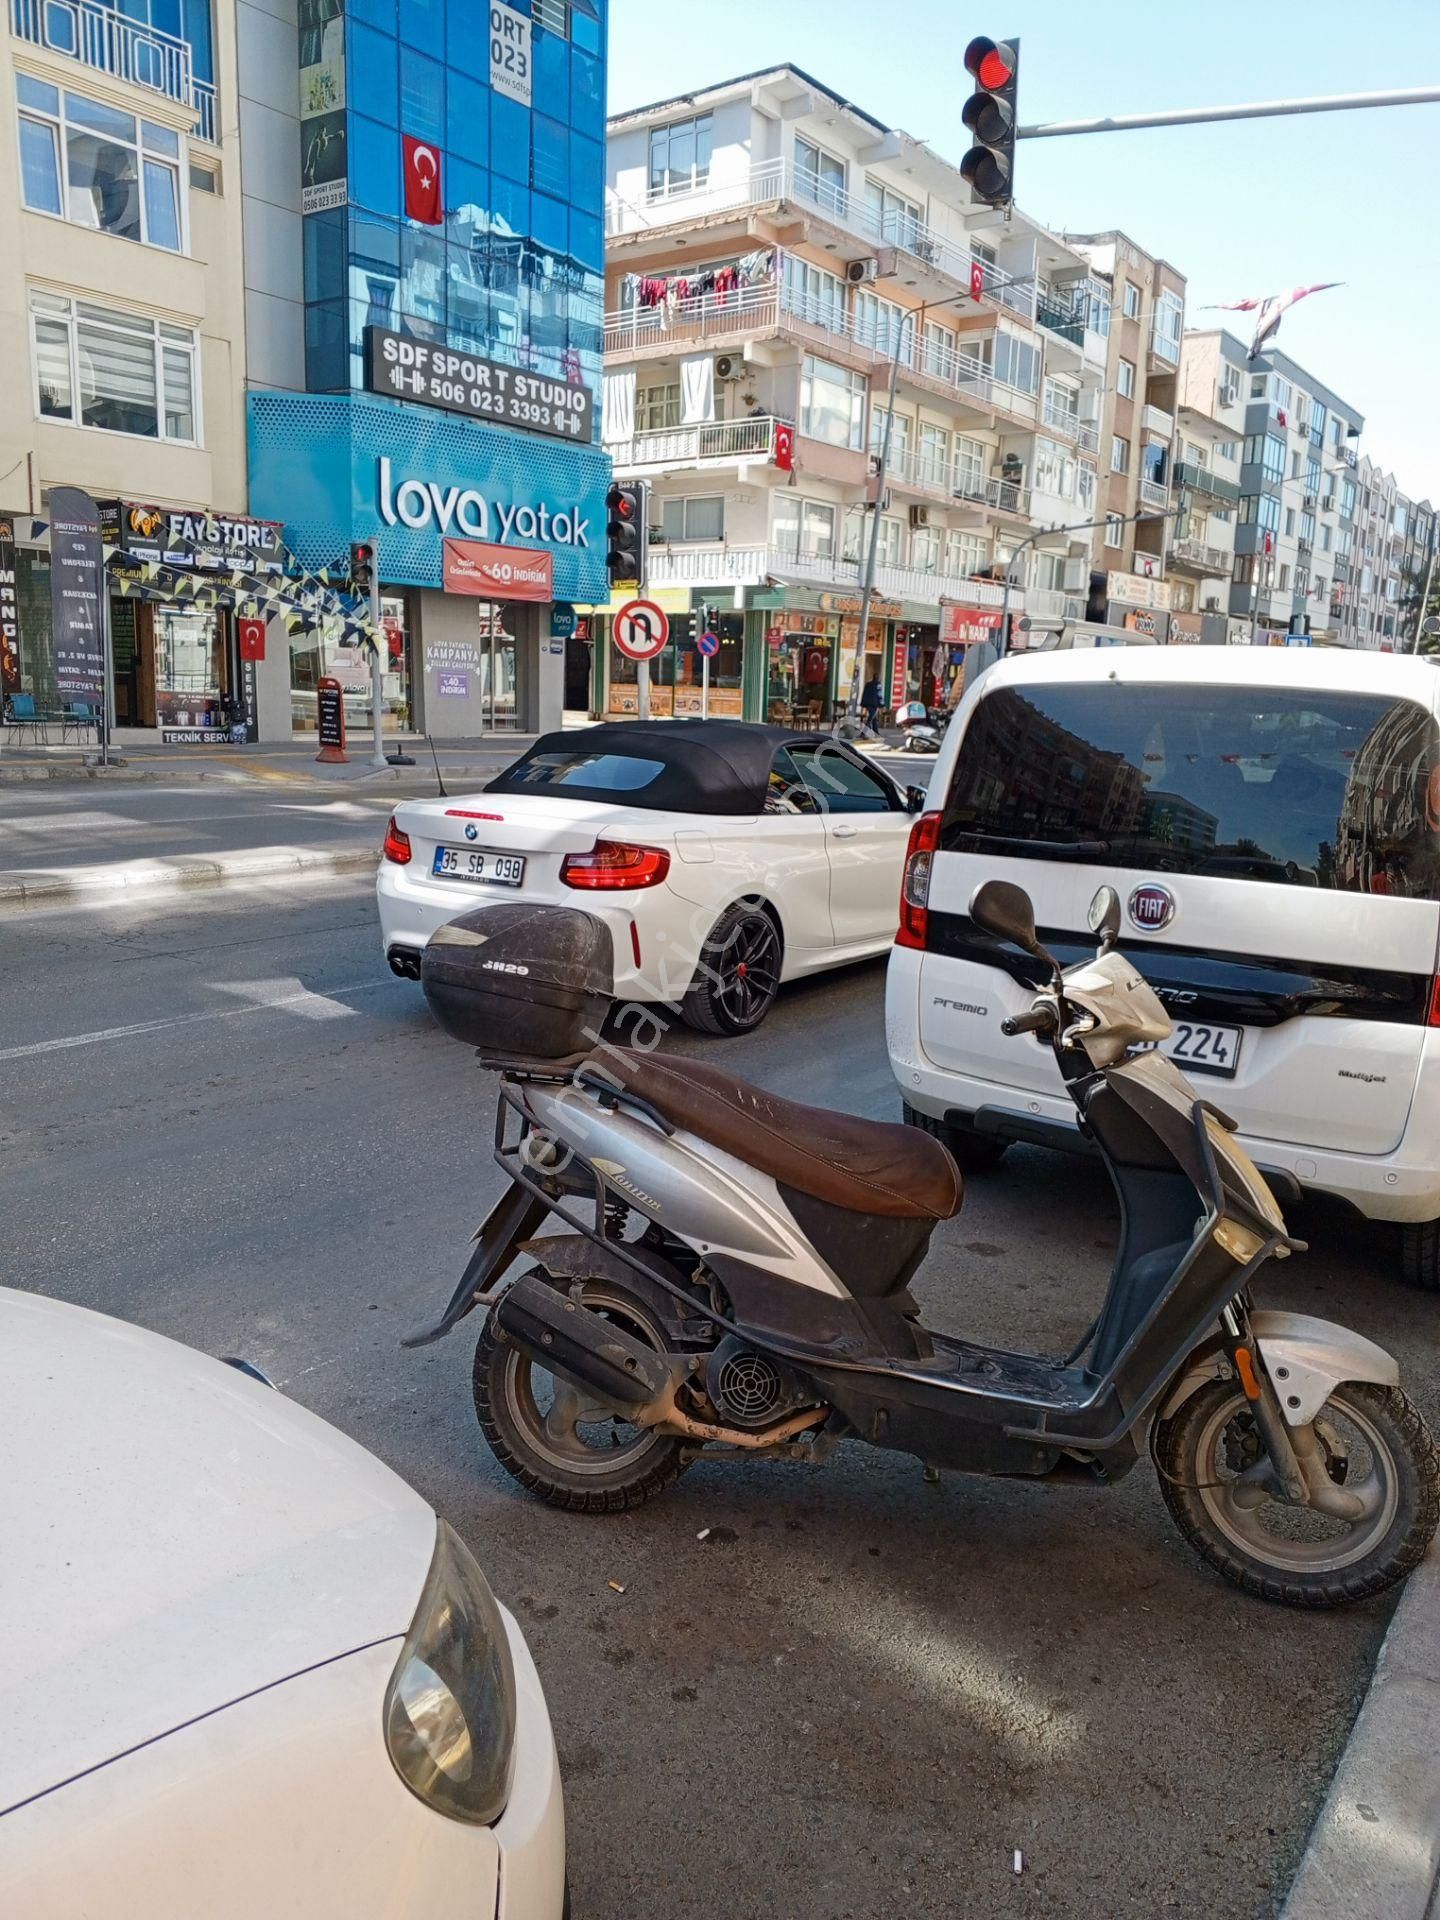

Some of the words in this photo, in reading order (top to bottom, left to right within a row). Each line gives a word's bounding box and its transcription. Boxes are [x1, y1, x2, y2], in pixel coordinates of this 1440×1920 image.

[491, 9, 525, 45] ORT
[491, 39, 527, 78] 023
[303, 199, 318, 211] 0506
[318, 195, 329, 207] 023
[304, 188, 312, 197] SDF
[313, 185, 328, 194] SPORT
[328, 181, 345, 191] STUDIO
[383, 337, 428, 369] SDF
[514, 375, 586, 412] STUDIO
[430, 377, 465, 404] 506
[470, 388, 505, 414] 023
[509, 399, 551, 425] 3393
[380, 456, 489, 538] lova
[496, 501, 590, 548] yatak
[170, 514, 274, 549] FAYSTORE
[482, 562, 512, 580] %60
[426, 646, 480, 662] KAMPANYA
[164, 732, 202, 743] TEKNİK
[203, 732, 230, 743] SERV
[441, 851, 459, 871] 35
[468, 855, 485, 874] SB
[495, 858, 521, 879] 098
[1138, 897, 1165, 919] FIAT
[1173, 1024, 1228, 1063] 224
